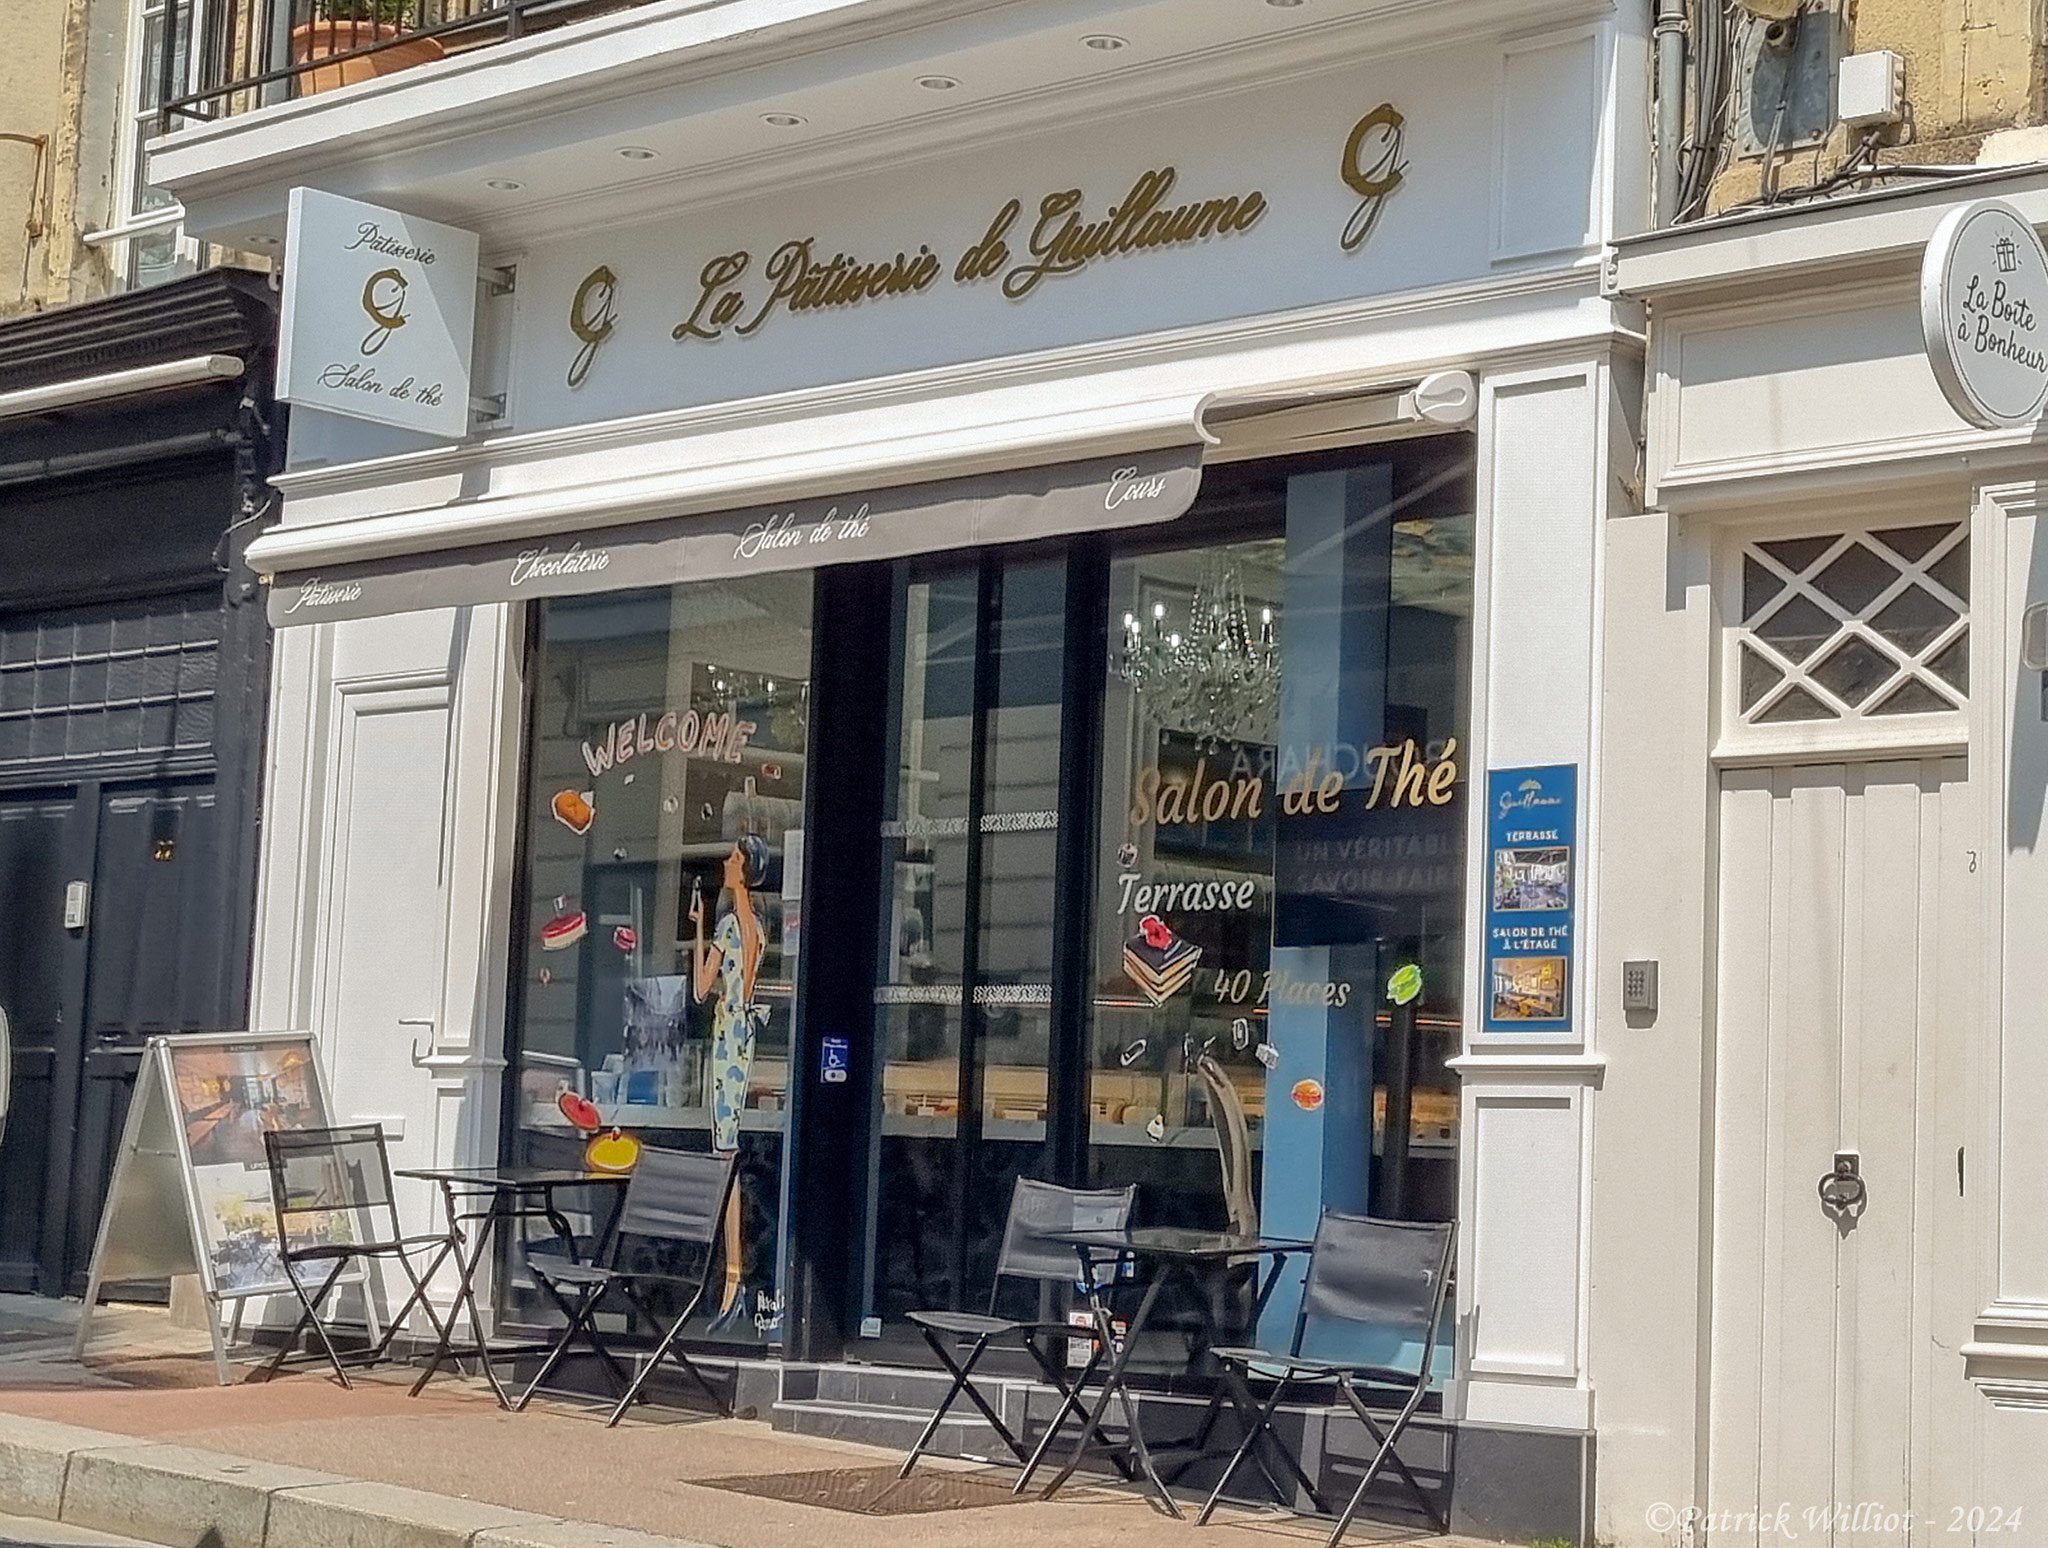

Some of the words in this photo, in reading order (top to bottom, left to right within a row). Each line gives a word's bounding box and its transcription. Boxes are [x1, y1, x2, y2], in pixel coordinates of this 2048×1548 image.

[344, 222, 436, 265] Pâtisserie
[672, 251, 749, 340] La
[735, 236, 941, 335] Pâtisserie
[953, 198, 1020, 283] de
[1001, 166, 1267, 299] Guillaume
[1962, 274, 1989, 313] La
[1991, 279, 2036, 331] Boîte
[1957, 313, 1971, 342] à
[1974, 314, 2047, 373] Bonheur
[317, 363, 383, 393] Salon
[388, 376, 415, 400] de
[415, 383, 443, 406] thé
[1104, 465, 1166, 510] Cours
[733, 513, 803, 560] Salon
[809, 506, 838, 544] de
[838, 503, 871, 540] thé
[510, 541, 611, 586] Chocolaterie
[582, 709, 757, 777] WELCOME
[1129, 757, 1263, 827] Salon
[1283, 747, 1345, 815] de
[1365, 738, 1457, 810] Thé
[1506, 829, 1559, 842] TERRASSE
[1117, 872, 1255, 915] Terrasse
[1492, 926, 1528, 938] SALON
[1530, 926, 1546, 938] DE
[1213, 968, 1251, 1003] 40
[1257, 966, 1351, 1008] Places
